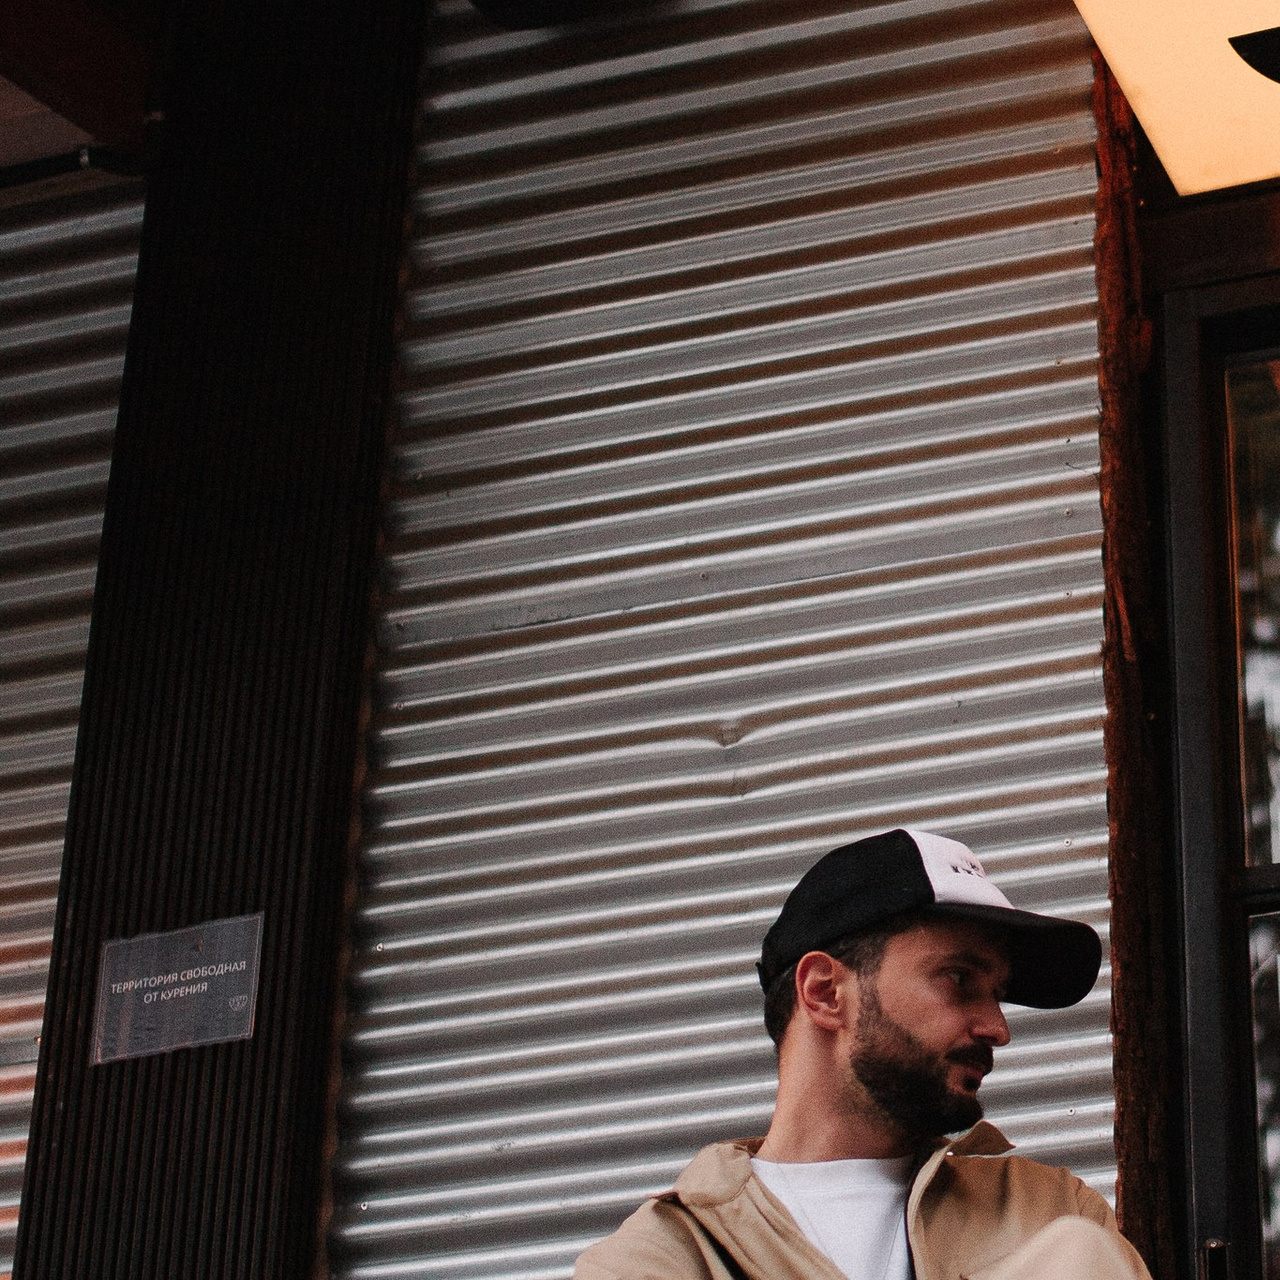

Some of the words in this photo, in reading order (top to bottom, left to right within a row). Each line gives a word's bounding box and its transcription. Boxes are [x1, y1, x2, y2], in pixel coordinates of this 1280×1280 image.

[111, 972, 178, 994] ТЕРРИТОРИЯ
[180, 960, 247, 981] СВОБОДНАЯ
[143, 992, 158, 1004] ОТ
[160, 982, 208, 1001] КУРЕНИЯ
